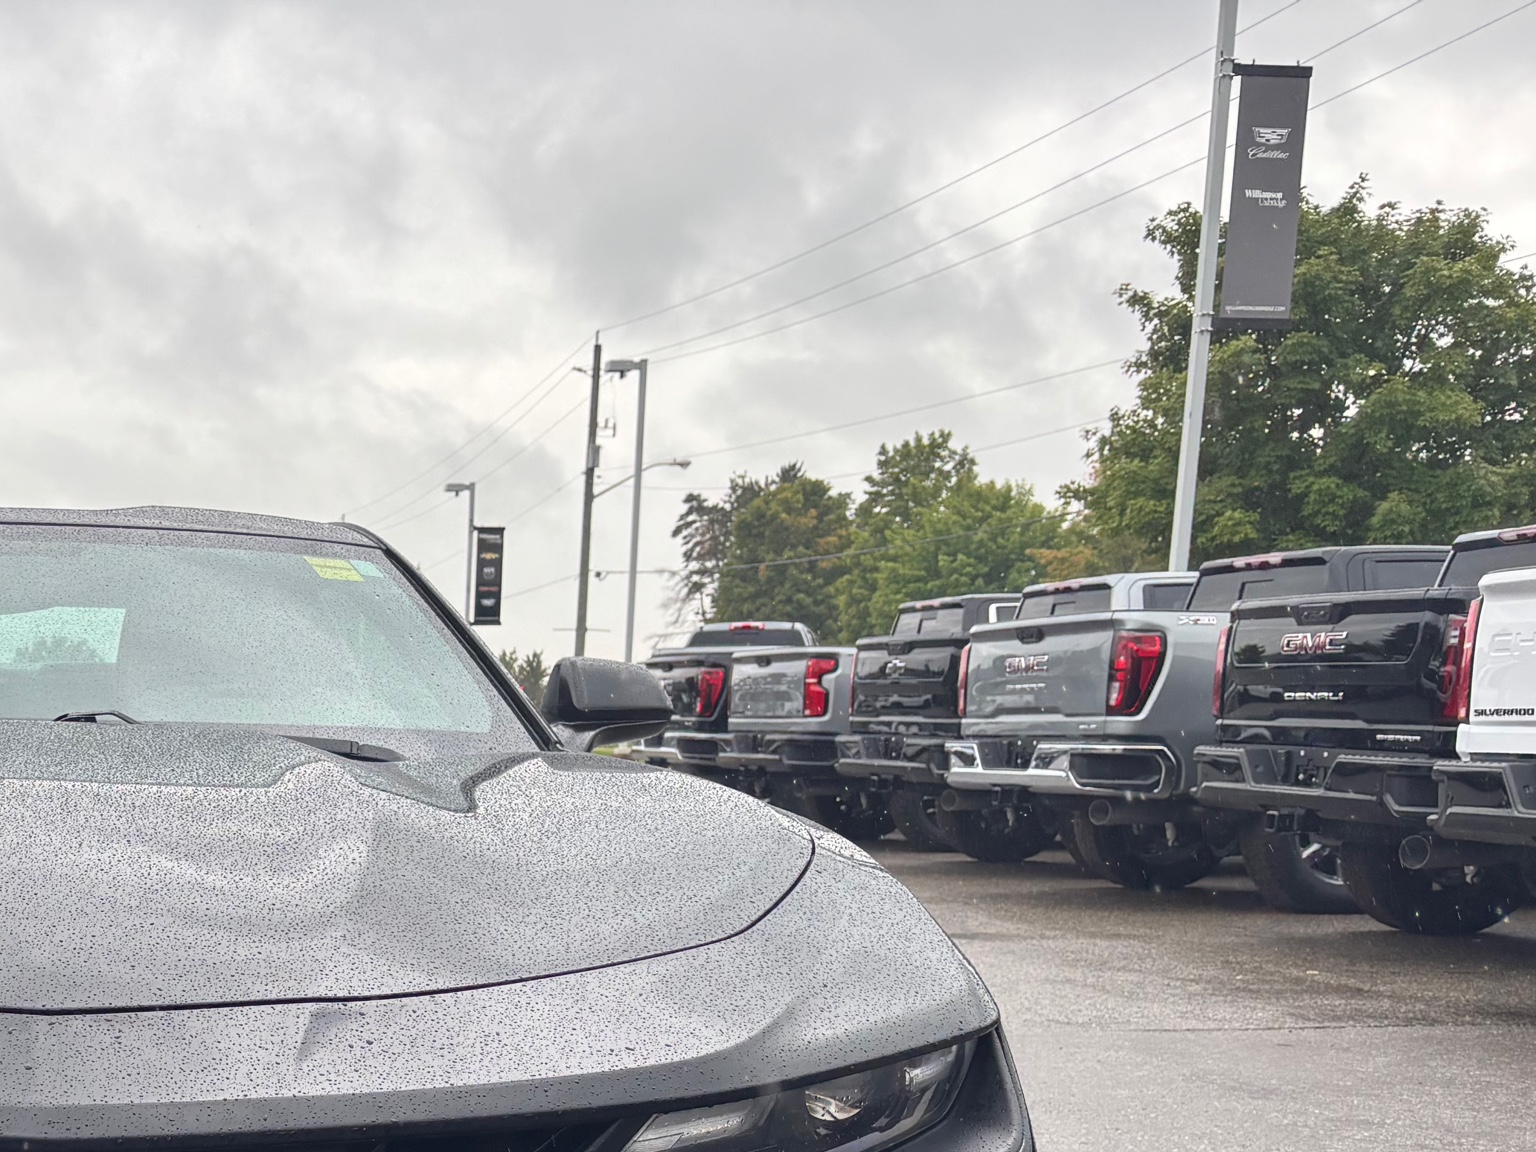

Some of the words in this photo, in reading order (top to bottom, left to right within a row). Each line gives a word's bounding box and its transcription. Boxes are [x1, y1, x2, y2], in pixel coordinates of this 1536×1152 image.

[1248, 146, 1290, 159] Cadillac
[1245, 189, 1283, 199] Williamson
[1280, 631, 1348, 654] GMC
[1004, 655, 1049, 673] GMC
[1284, 692, 1344, 701] DENALI
[1473, 708, 1535, 717] SILVERADO
